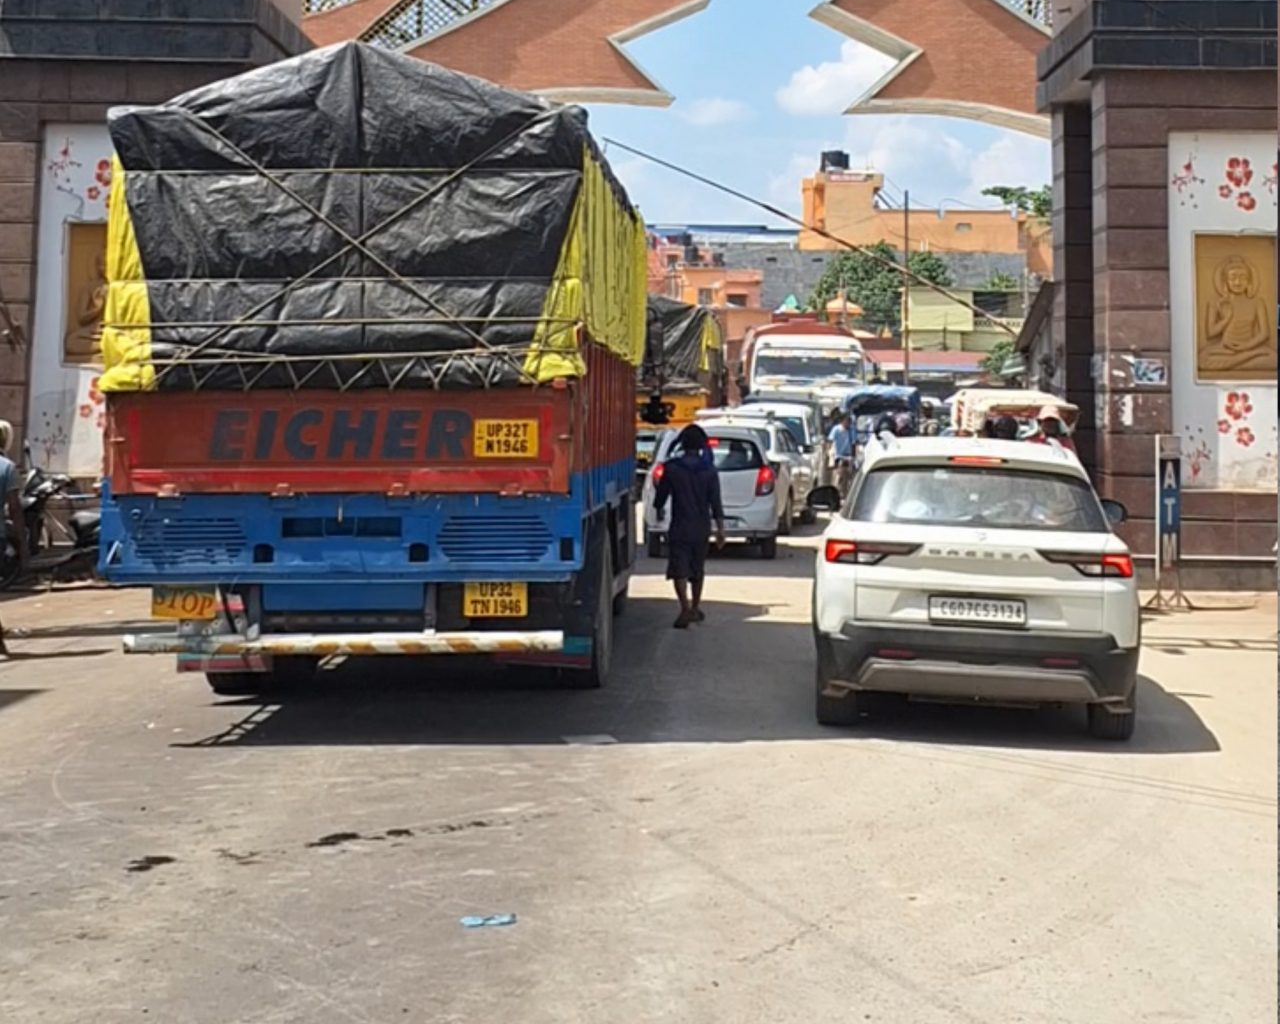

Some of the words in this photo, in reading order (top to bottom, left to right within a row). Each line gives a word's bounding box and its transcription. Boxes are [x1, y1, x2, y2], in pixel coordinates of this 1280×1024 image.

[209, 409, 471, 460] EICHER
[486, 422, 529, 438] UP32T
[486, 439, 528, 454] N1946
[1162, 460, 1178, 568] ATM
[154, 585, 214, 616] STOP
[479, 582, 512, 597] UP32
